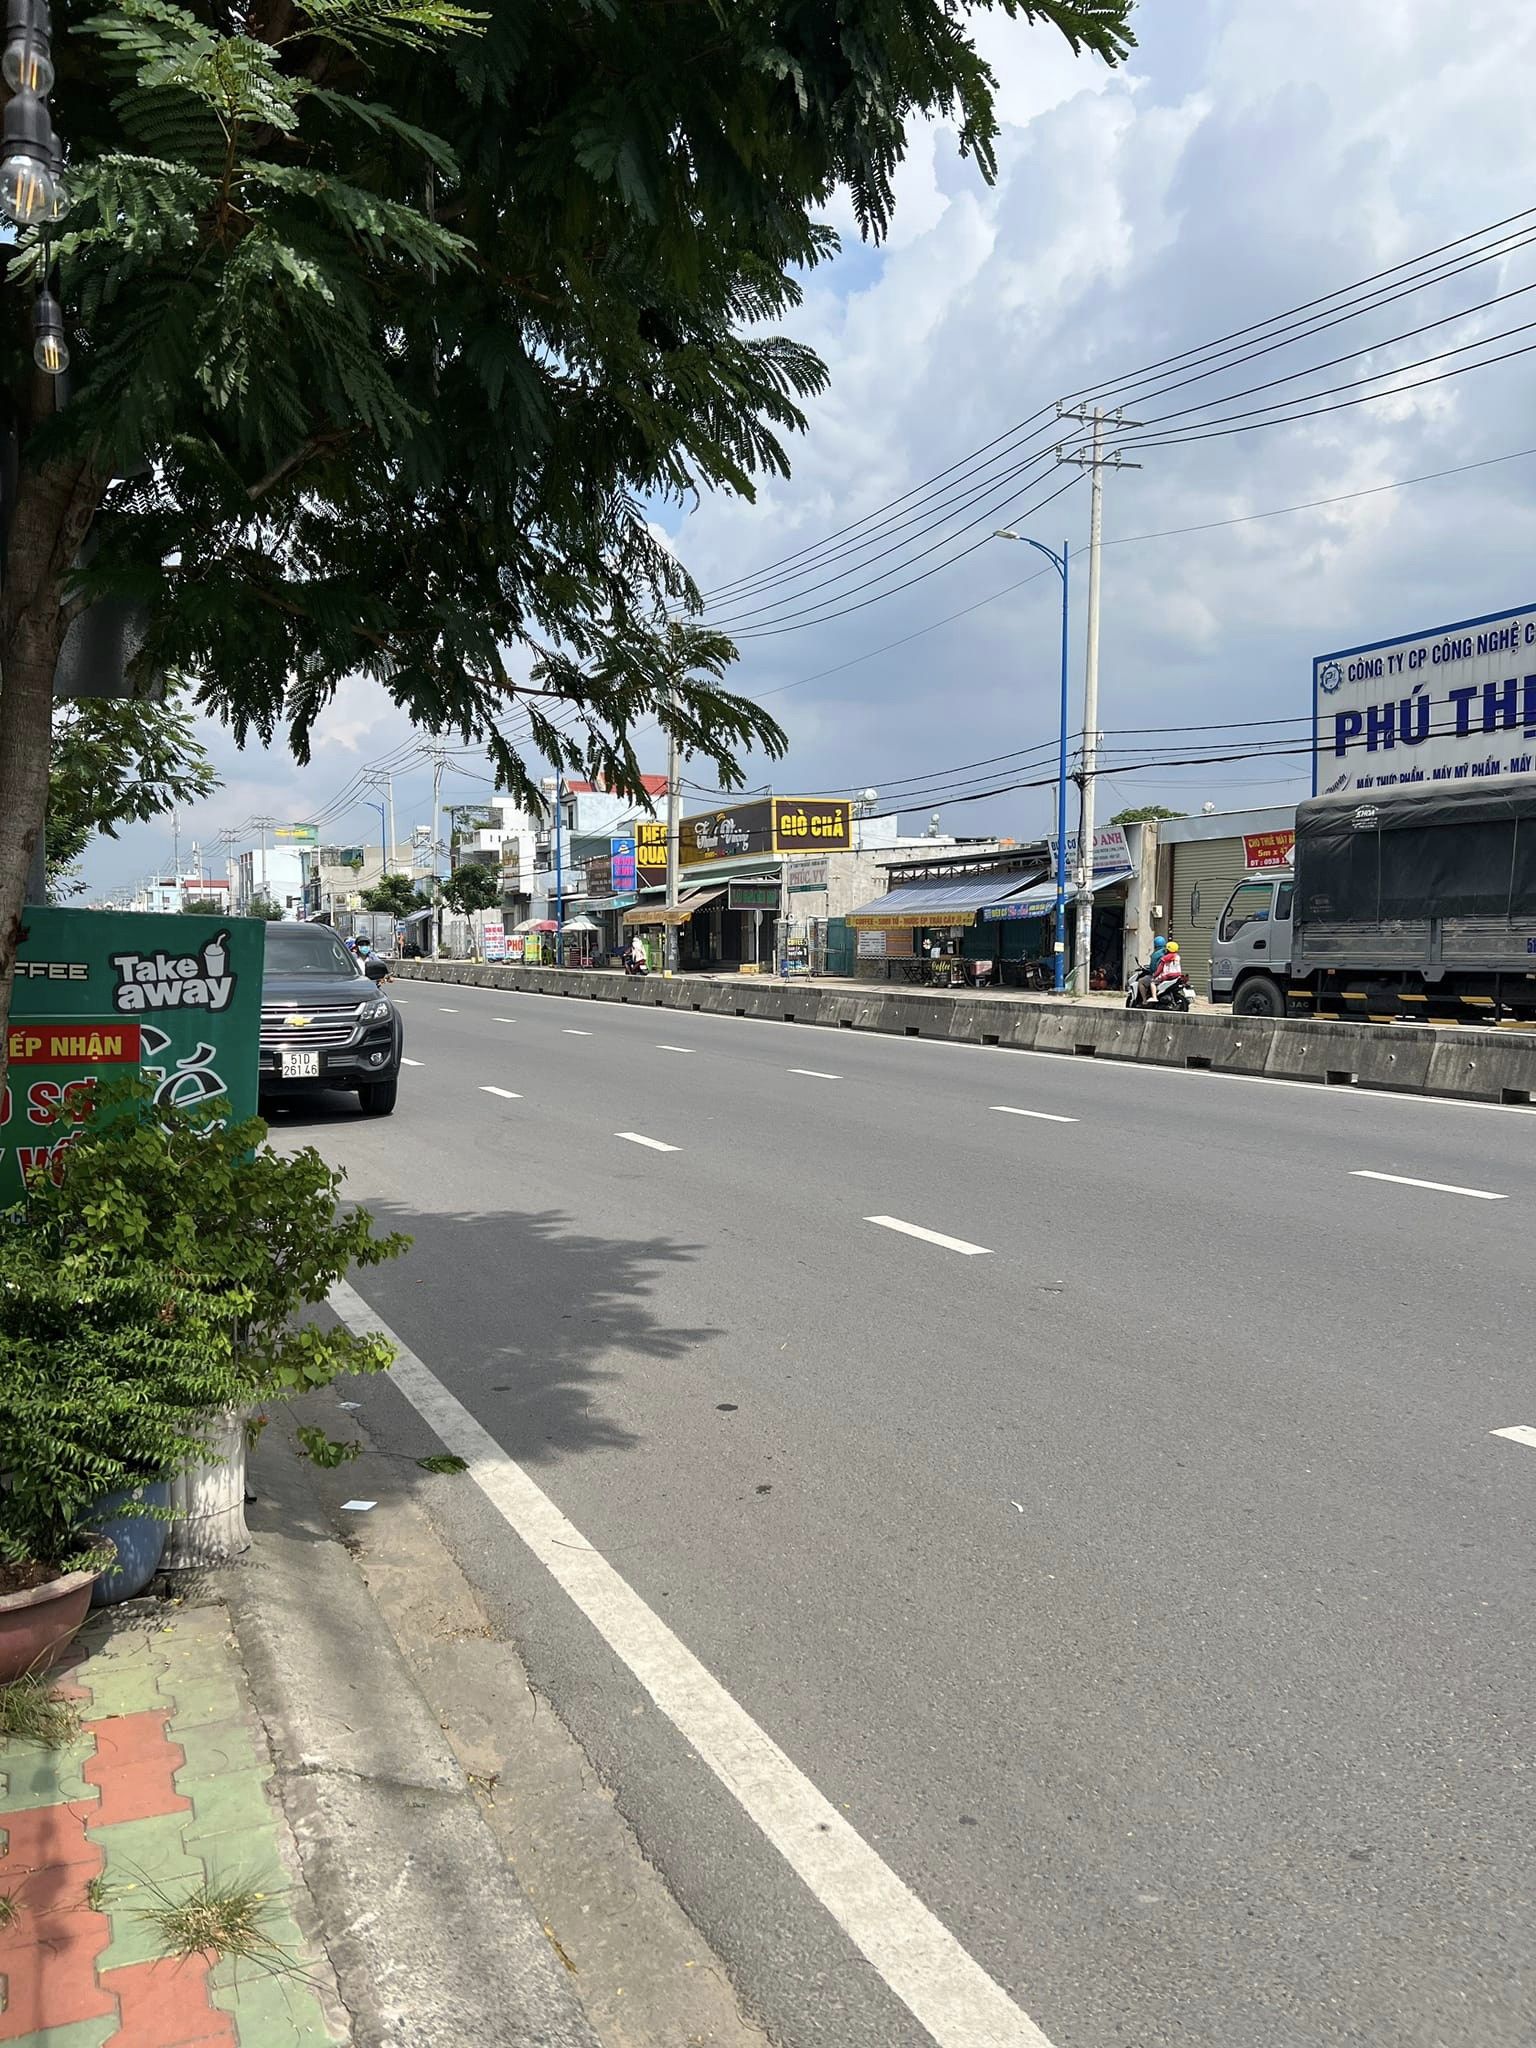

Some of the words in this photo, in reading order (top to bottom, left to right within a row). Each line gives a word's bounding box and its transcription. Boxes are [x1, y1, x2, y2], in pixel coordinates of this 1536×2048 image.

[1348, 657, 1383, 682] CÔNG
[1388, 653, 1404, 674] TY
[1408, 648, 1427, 669] CP
[1432, 637, 1472, 664] CÔNG
[1477, 621, 1519, 653] NGHỆ
[1335, 683, 1430, 757] PHÚ
[1356, 774, 1374, 789] MÁY
[1433, 764, 1452, 780] MÁY
[1471, 755, 1501, 777] PHẨM
[1510, 753, 1532, 773] MÁY
[780, 809, 808, 837] GIÒ
[811, 809, 844, 837] CHẢ
[1101, 833, 1123, 846] ANH
[639, 845, 668, 866] QUA
[789, 868, 811, 886] PHÚC
[812, 868, 826, 883] VY
[114, 954, 199, 983] Take
[117, 976, 233, 1010] away
[51, 1032, 123, 1060] NHẬN
[291, 1053, 310, 1065] 51D
